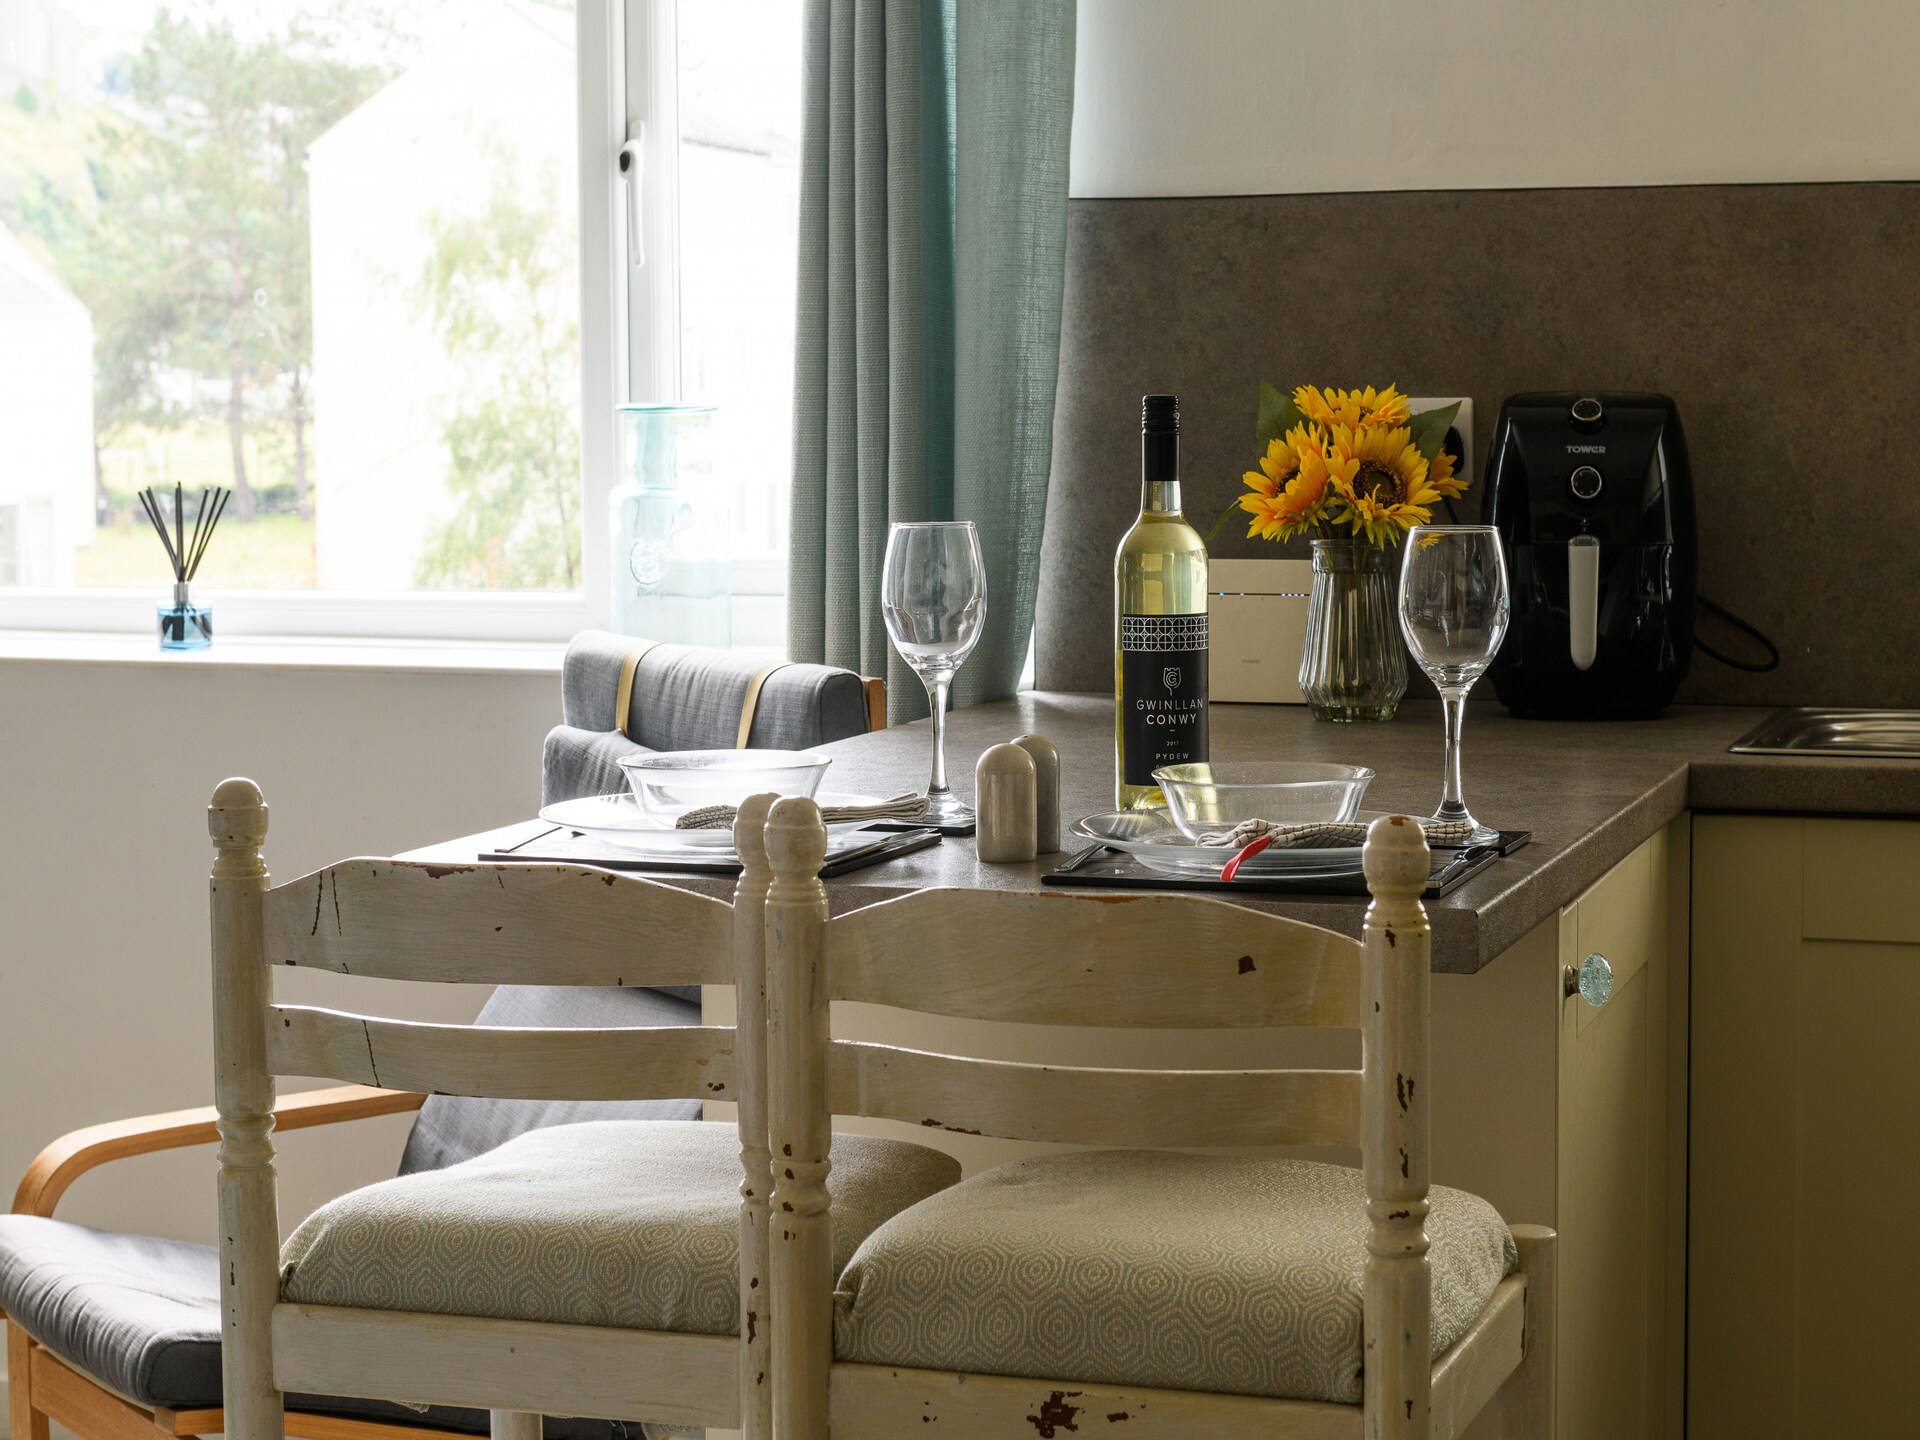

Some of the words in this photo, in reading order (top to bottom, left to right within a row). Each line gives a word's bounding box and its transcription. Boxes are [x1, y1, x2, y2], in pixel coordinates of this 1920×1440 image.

[1566, 445, 1606, 454] TOWER
[1136, 699, 1203, 710] GWINLLAN
[1146, 713, 1197, 725] CONWY
[1155, 752, 1189, 760] PYDEW
